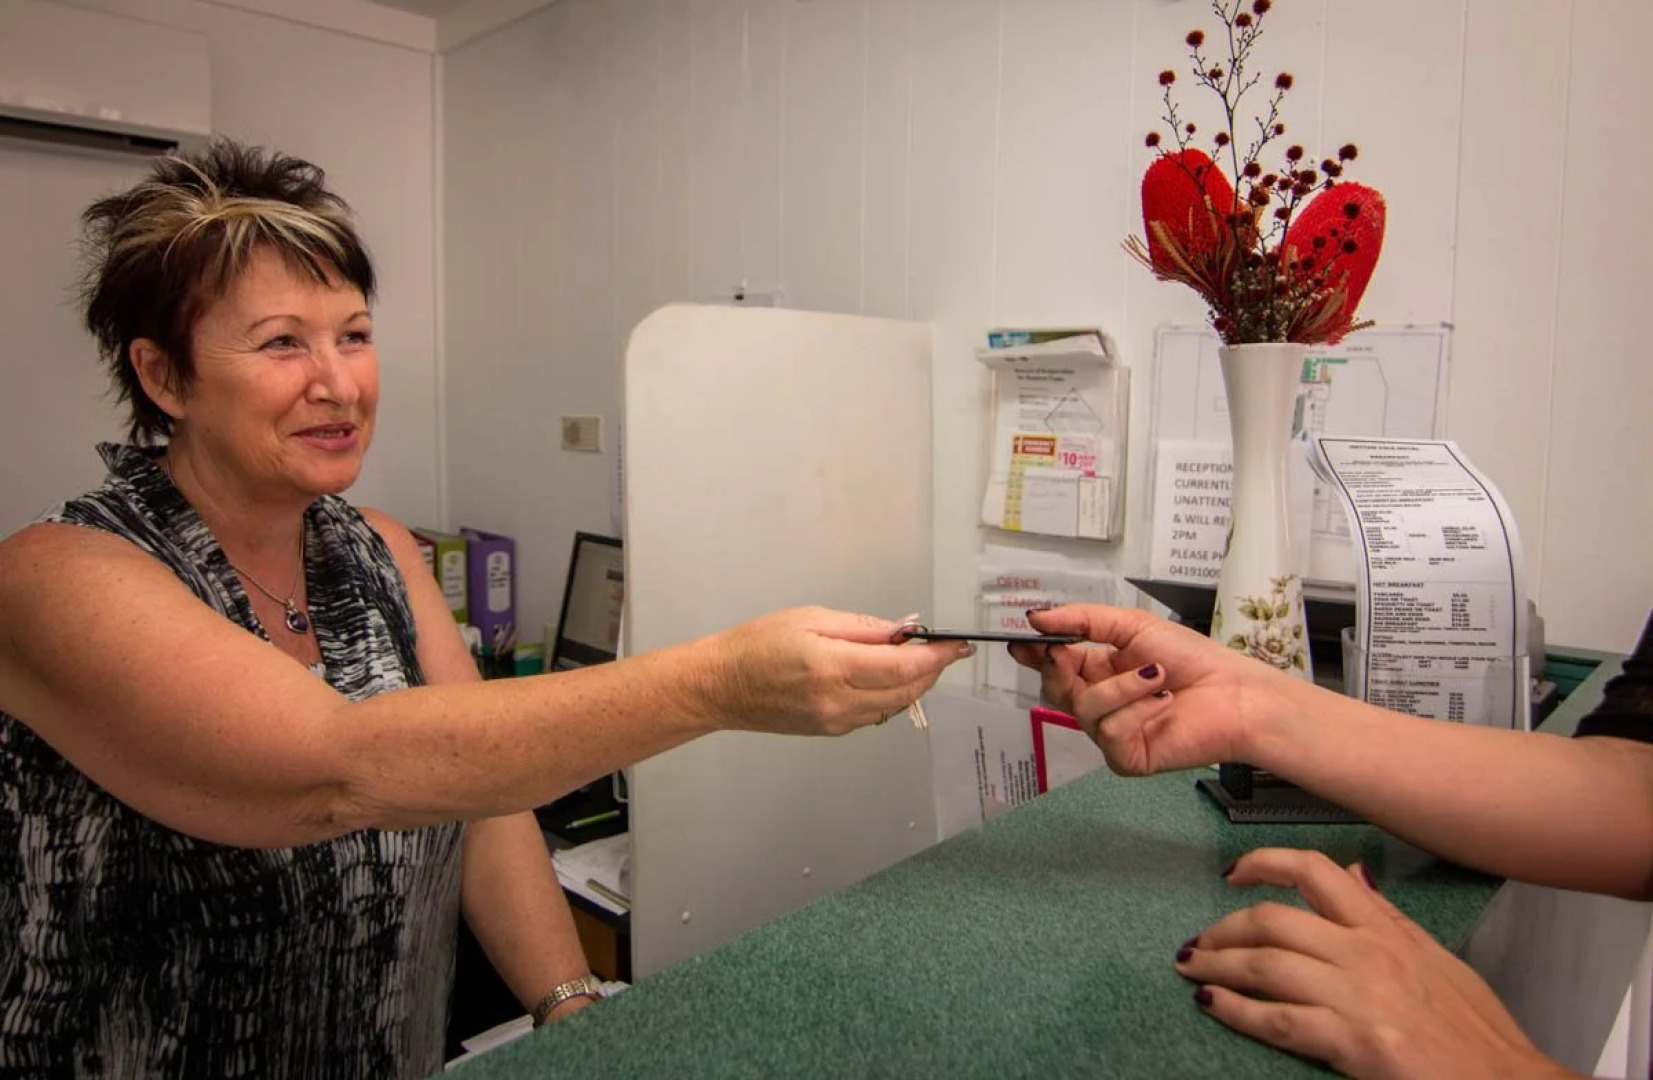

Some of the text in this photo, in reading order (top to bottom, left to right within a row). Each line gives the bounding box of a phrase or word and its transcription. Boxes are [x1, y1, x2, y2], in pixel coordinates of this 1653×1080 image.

[1174, 479, 1233, 490] CURRENTL
[1172, 513, 1181, 524] &
[1185, 514, 1209, 525] WILL
[1172, 529, 1197, 541] 2PM
[1170, 548, 1208, 560] PLEASE
[996, 575, 1041, 590] OFFICE
